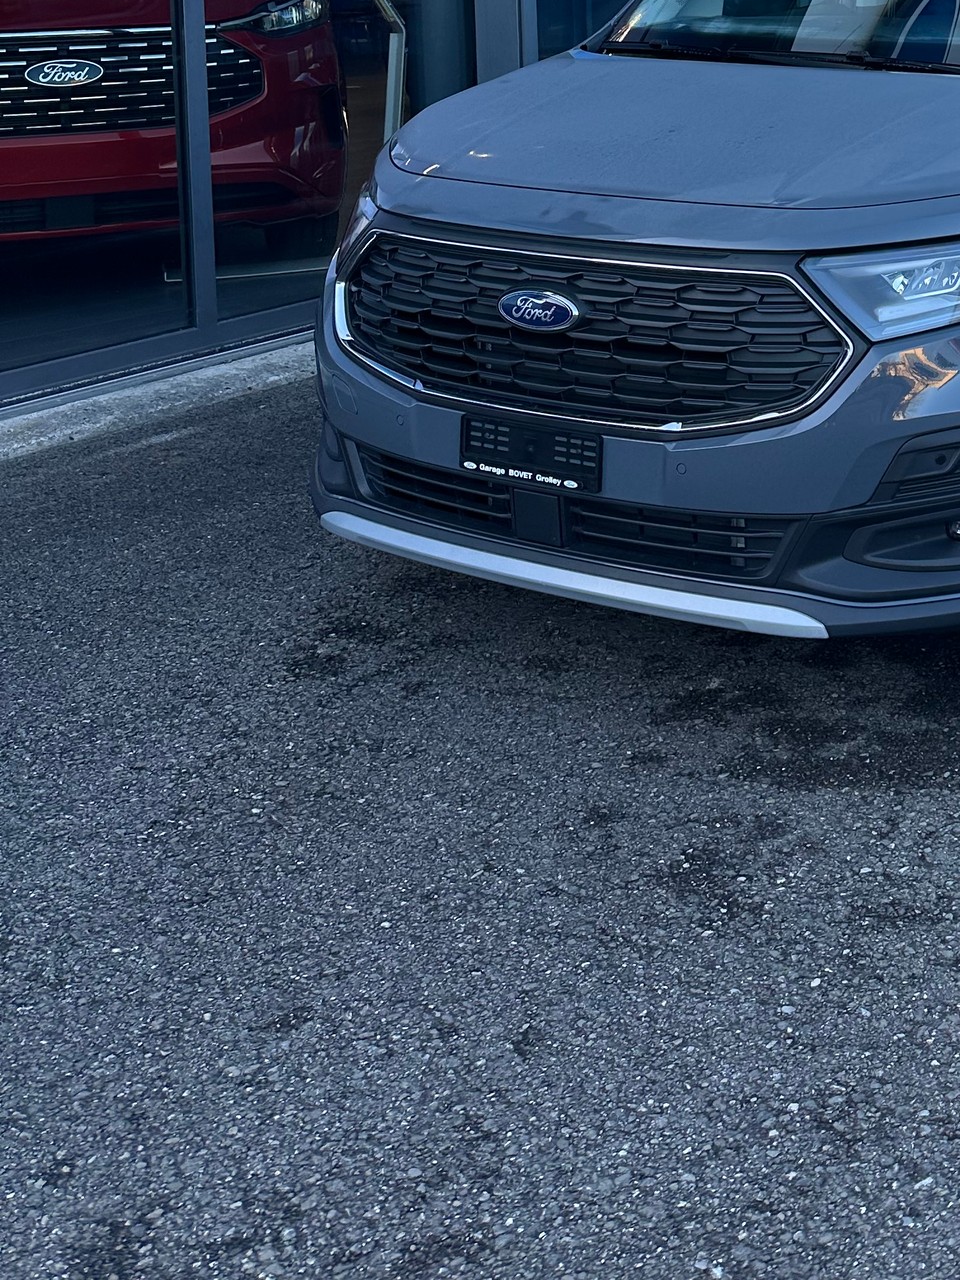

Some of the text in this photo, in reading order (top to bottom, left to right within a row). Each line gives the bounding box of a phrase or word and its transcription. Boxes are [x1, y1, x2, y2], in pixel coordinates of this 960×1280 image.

[38, 63, 90, 82] Ford
[512, 295, 557, 322] Ford
[479, 463, 506, 475] Garage
[508, 469, 533, 480] BOVET
[535, 474, 562, 487] Grolley
